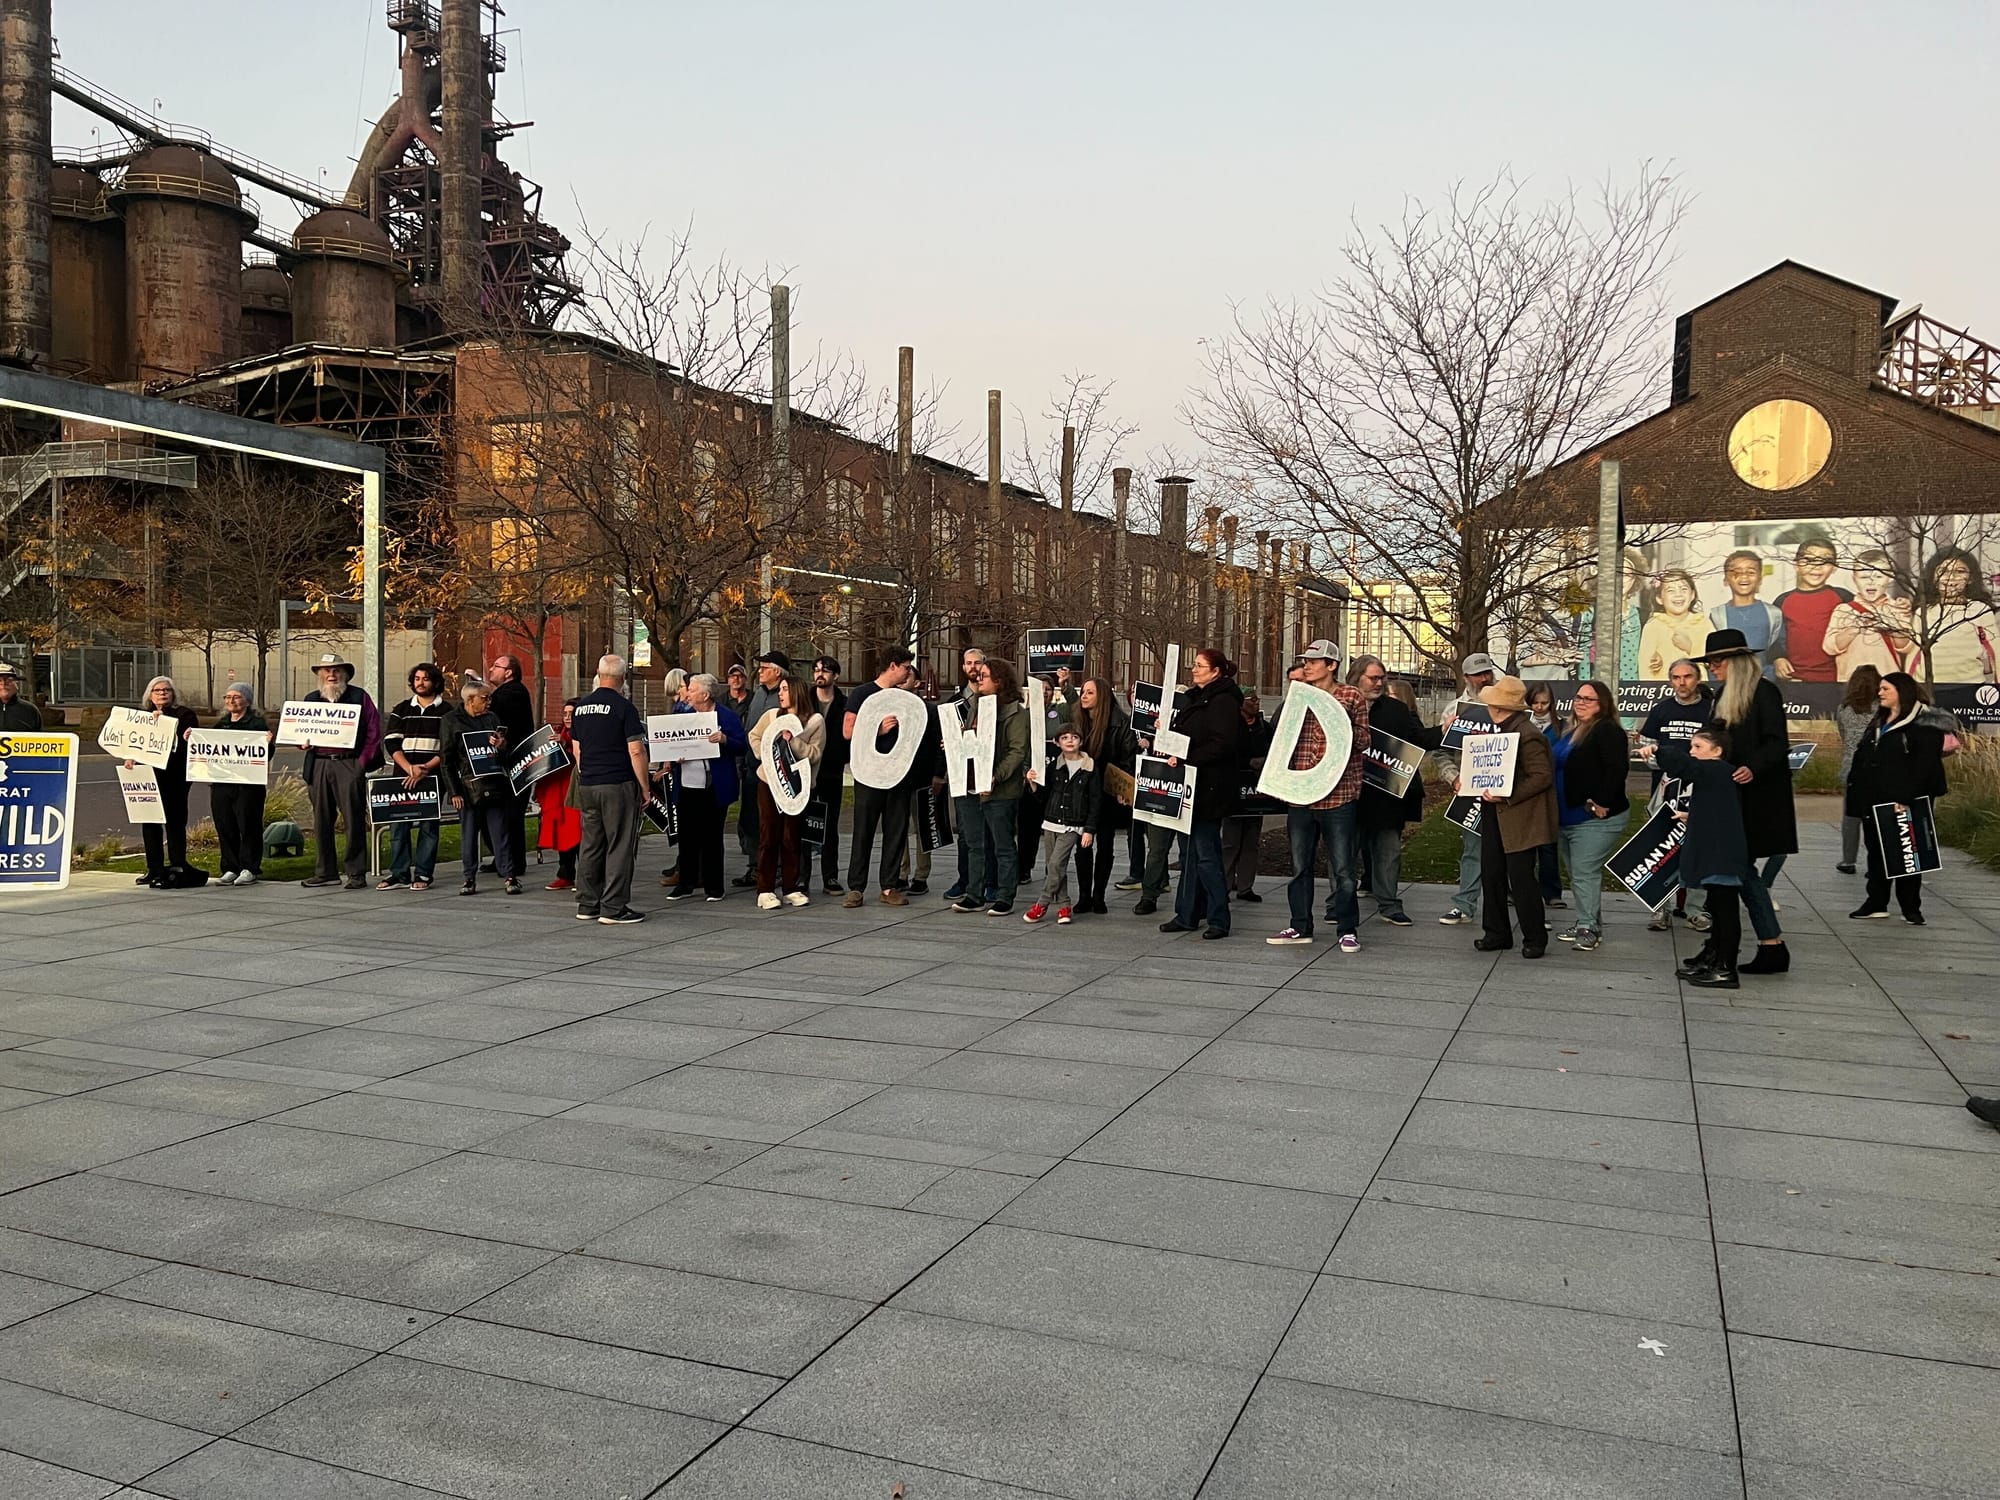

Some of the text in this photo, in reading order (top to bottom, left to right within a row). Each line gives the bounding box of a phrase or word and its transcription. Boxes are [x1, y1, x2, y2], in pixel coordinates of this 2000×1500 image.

[1029, 643, 1085, 653] SUSAN WILD
[1658, 685, 1676, 697] fa
[127, 710, 160, 729] Women
[285, 707, 357, 719] SUSAN WILD
[1452, 717, 1491, 733] SUSAN
[103, 727, 169, 752] Won't Go Back!
[654, 728, 712, 739] SUSAN WILD
[13, 742, 65, 754] SUPPORT
[190, 743, 266, 758] SUSAN WILD
[1485, 737, 1510, 753] WILD
[510, 753, 533, 777] SUSAN
[531, 741, 558, 758] WILD
[1383, 753, 1415, 775] WILD
[1472, 753, 1503, 768] PROTECTS
[123, 782, 157, 792] SUSAN WILD
[1139, 776, 1161, 789] SUSAN
[1161, 780, 1183, 793] WILD
[1471, 774, 1505, 789] FREEDOMS
[371, 791, 437, 803] SUSAN WILD
[806, 818, 824, 829] SUS
[1897, 811, 1910, 837] WIL
[929, 816, 940, 849] SUSAN
[1624, 822, 1687, 887] SUSAN WILD
[1900, 836, 1916, 874] SUSAN
